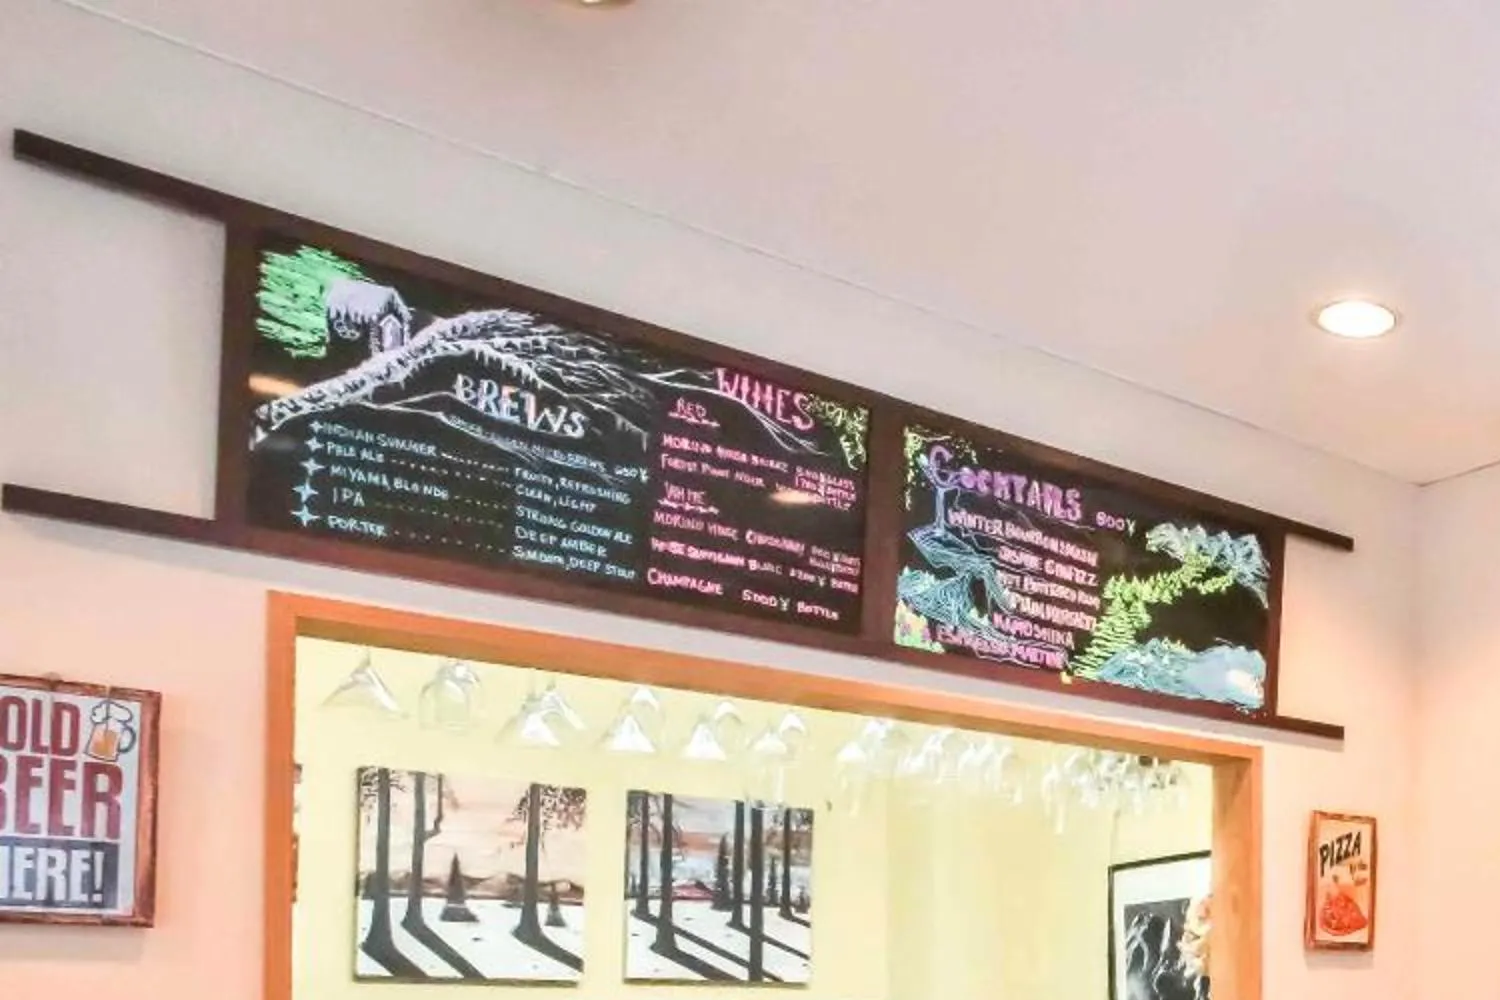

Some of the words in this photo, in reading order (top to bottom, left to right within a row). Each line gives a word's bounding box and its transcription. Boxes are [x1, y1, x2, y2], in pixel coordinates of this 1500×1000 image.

[454, 373, 586, 440] BREWS
[676, 398, 707, 418] RED
[715, 366, 814, 430] WINES
[360, 450, 384, 463] ALE
[377, 433, 437, 456] SUMMER
[929, 445, 1082, 522] COCKTAILS
[332, 487, 366, 507] IPA
[327, 514, 387, 537] PORTER
[516, 505, 567, 530] STRONG
[646, 567, 724, 596] CHAMPAGNE
[1319, 831, 1361, 877] PIZZA
